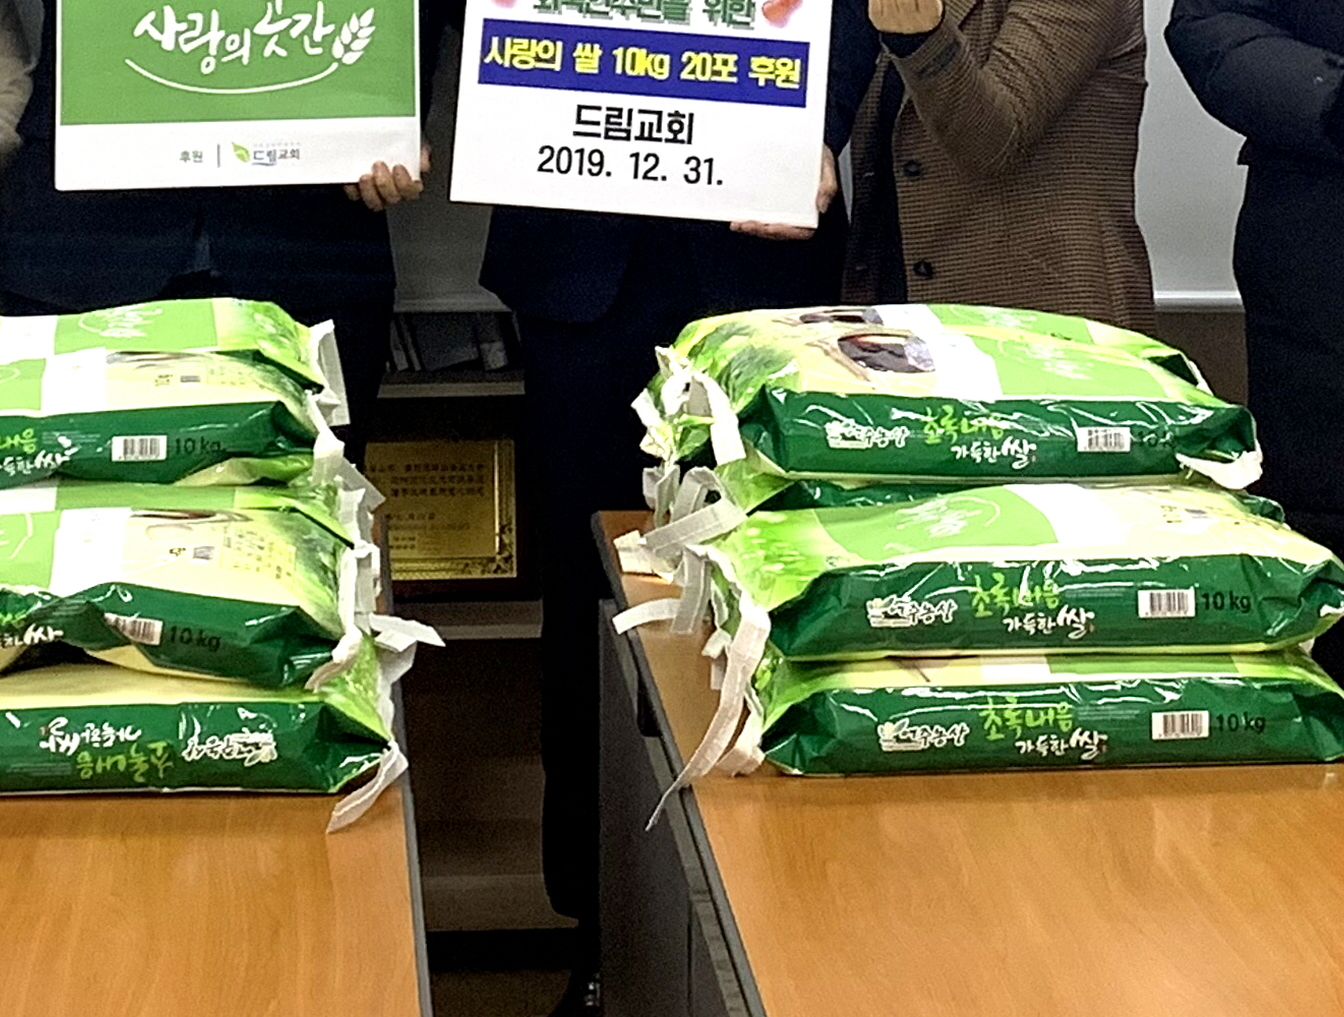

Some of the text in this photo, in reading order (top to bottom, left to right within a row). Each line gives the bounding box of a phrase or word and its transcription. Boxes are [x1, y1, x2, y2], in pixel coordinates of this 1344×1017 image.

[133, 5, 252, 75] 사랑의
[484, 35, 802, 90] 사랑의 쌀 10kg 20포 후원
[572, 103, 695, 145] 드림교회
[179, 149, 204, 163] 후원
[537, 145, 724, 186] 2019. 12. 31.
